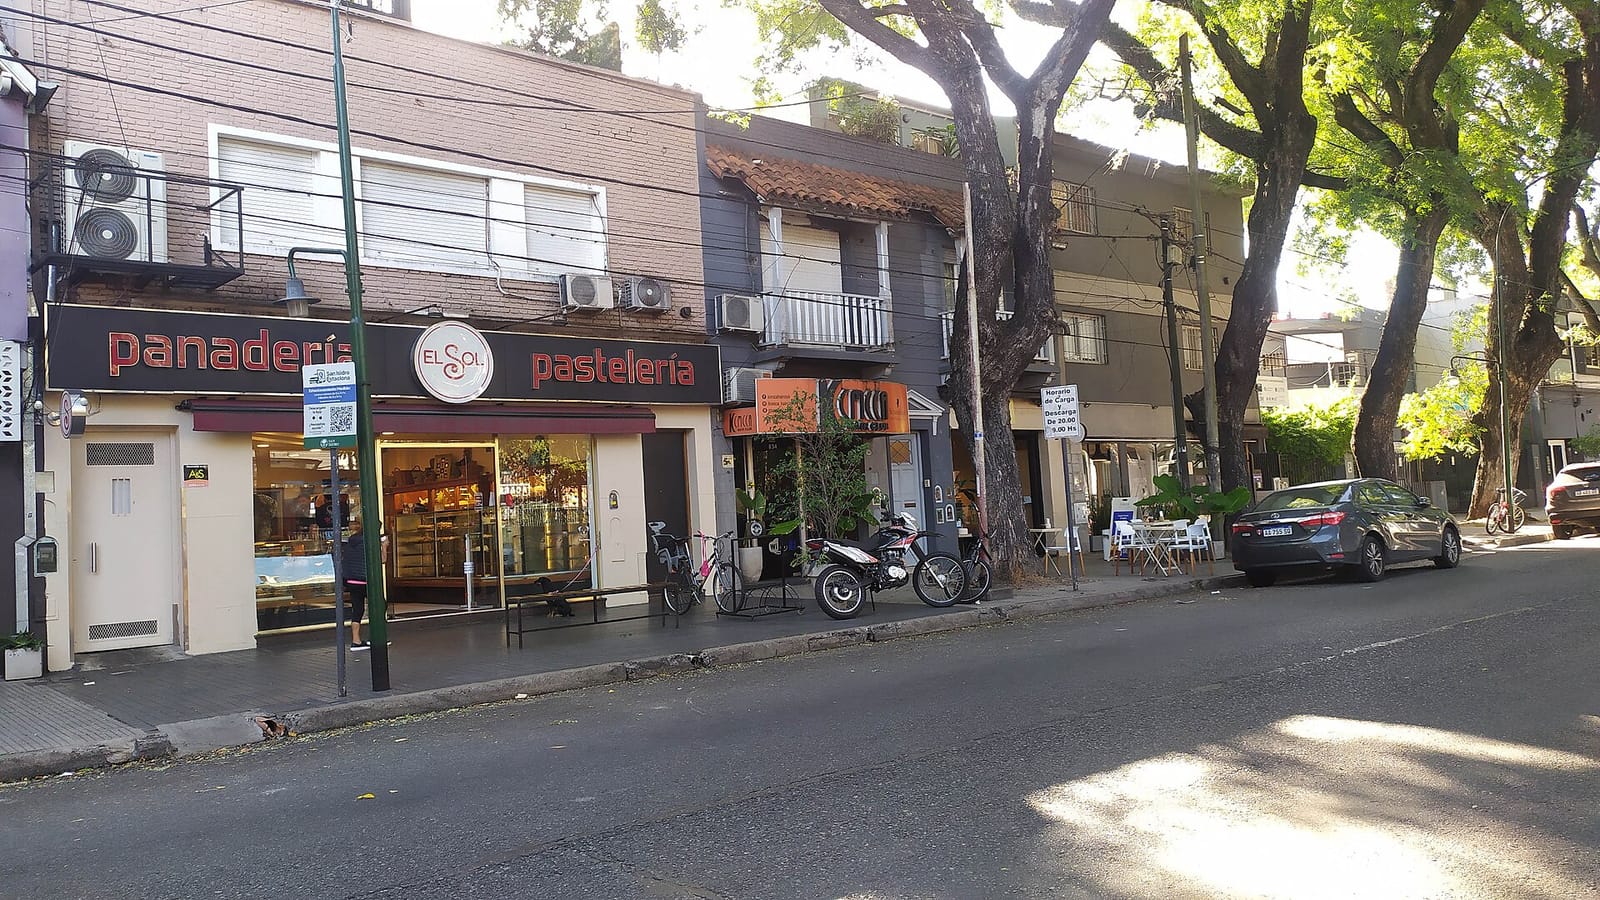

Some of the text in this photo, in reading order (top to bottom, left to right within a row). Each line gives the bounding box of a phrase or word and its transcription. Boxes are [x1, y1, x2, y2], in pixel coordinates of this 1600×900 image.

[424, 344, 484, 380] EL SOL
[531, 347, 695, 390] pastelería
